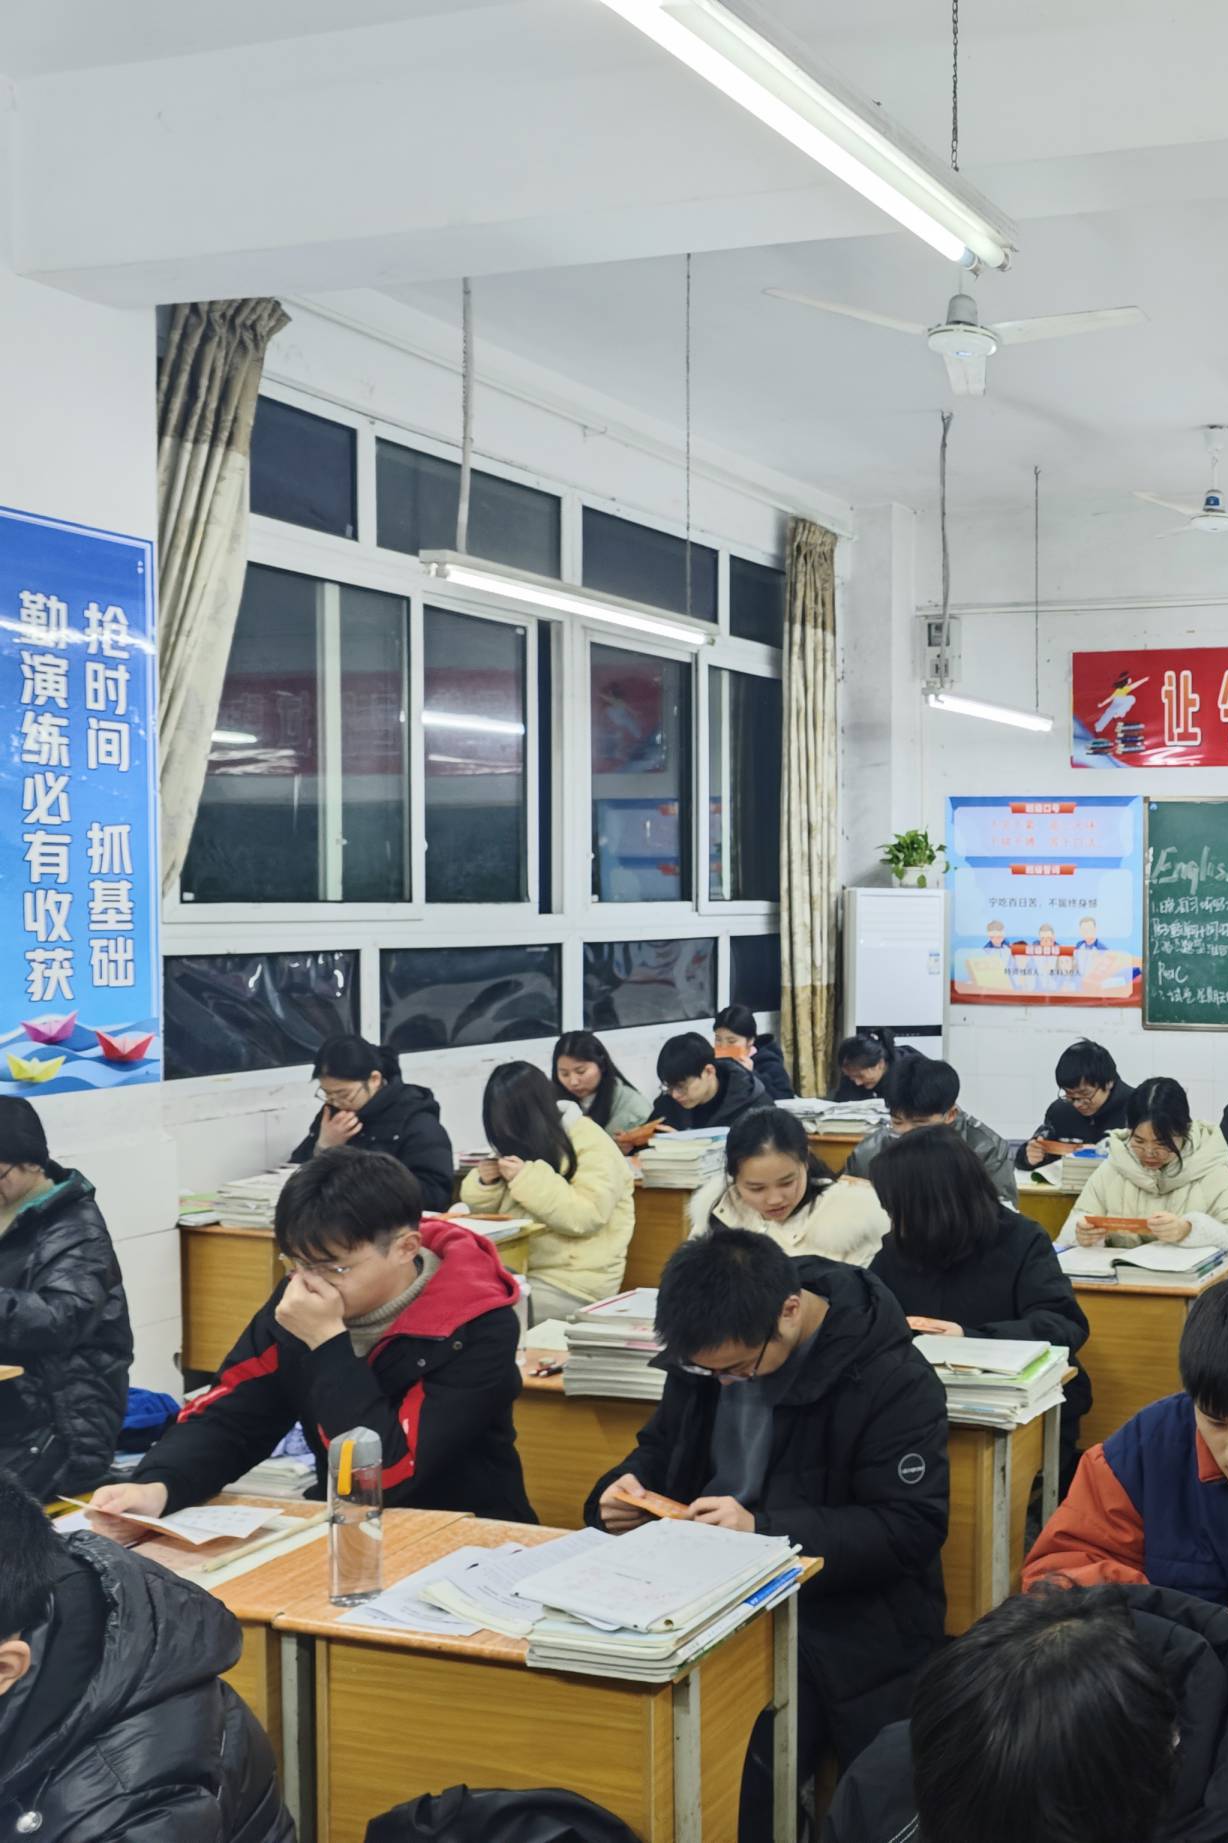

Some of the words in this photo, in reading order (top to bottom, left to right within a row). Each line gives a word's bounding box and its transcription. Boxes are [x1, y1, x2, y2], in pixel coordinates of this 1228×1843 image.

[84, 602, 131, 774] 抢时间
[18, 590, 75, 1003] 勤演练必有收获
[86, 822, 136, 988] 抓基础
